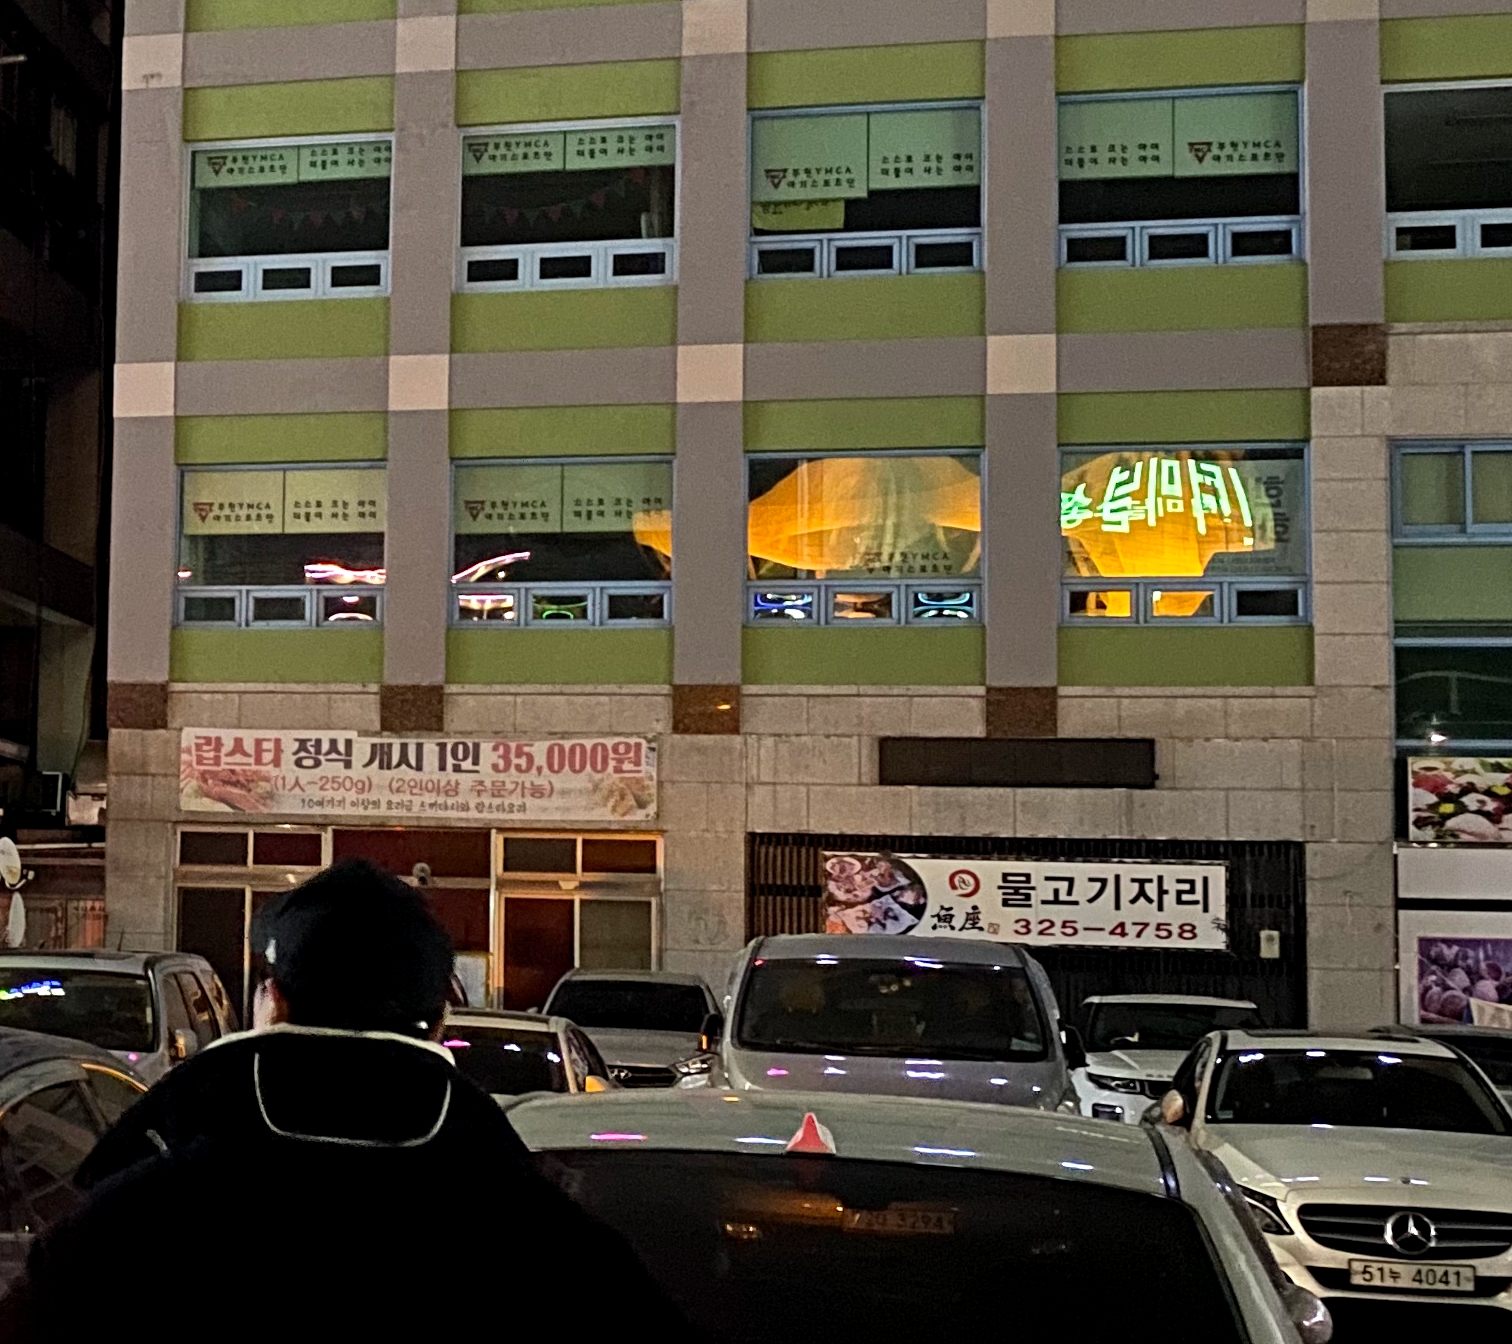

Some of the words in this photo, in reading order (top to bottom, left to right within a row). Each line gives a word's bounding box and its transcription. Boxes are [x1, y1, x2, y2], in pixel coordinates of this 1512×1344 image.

[194, 735, 284, 769] 랍스타
[292, 738, 353, 770] 정식
[362, 742, 425, 772] 개시
[436, 741, 481, 774] 1인
[491, 740, 643, 776] 35,000원
[388, 777, 460, 798] (2인이상
[470, 778, 555, 800] 주문가능)
[997, 871, 1210, 913] 물고기자리
[931, 905, 986, 933] 魚座
[1013, 918, 1198, 941] 325-4758
[1361, 1265, 1401, 1284] 51누
[1412, 1268, 1461, 1288] 4041
